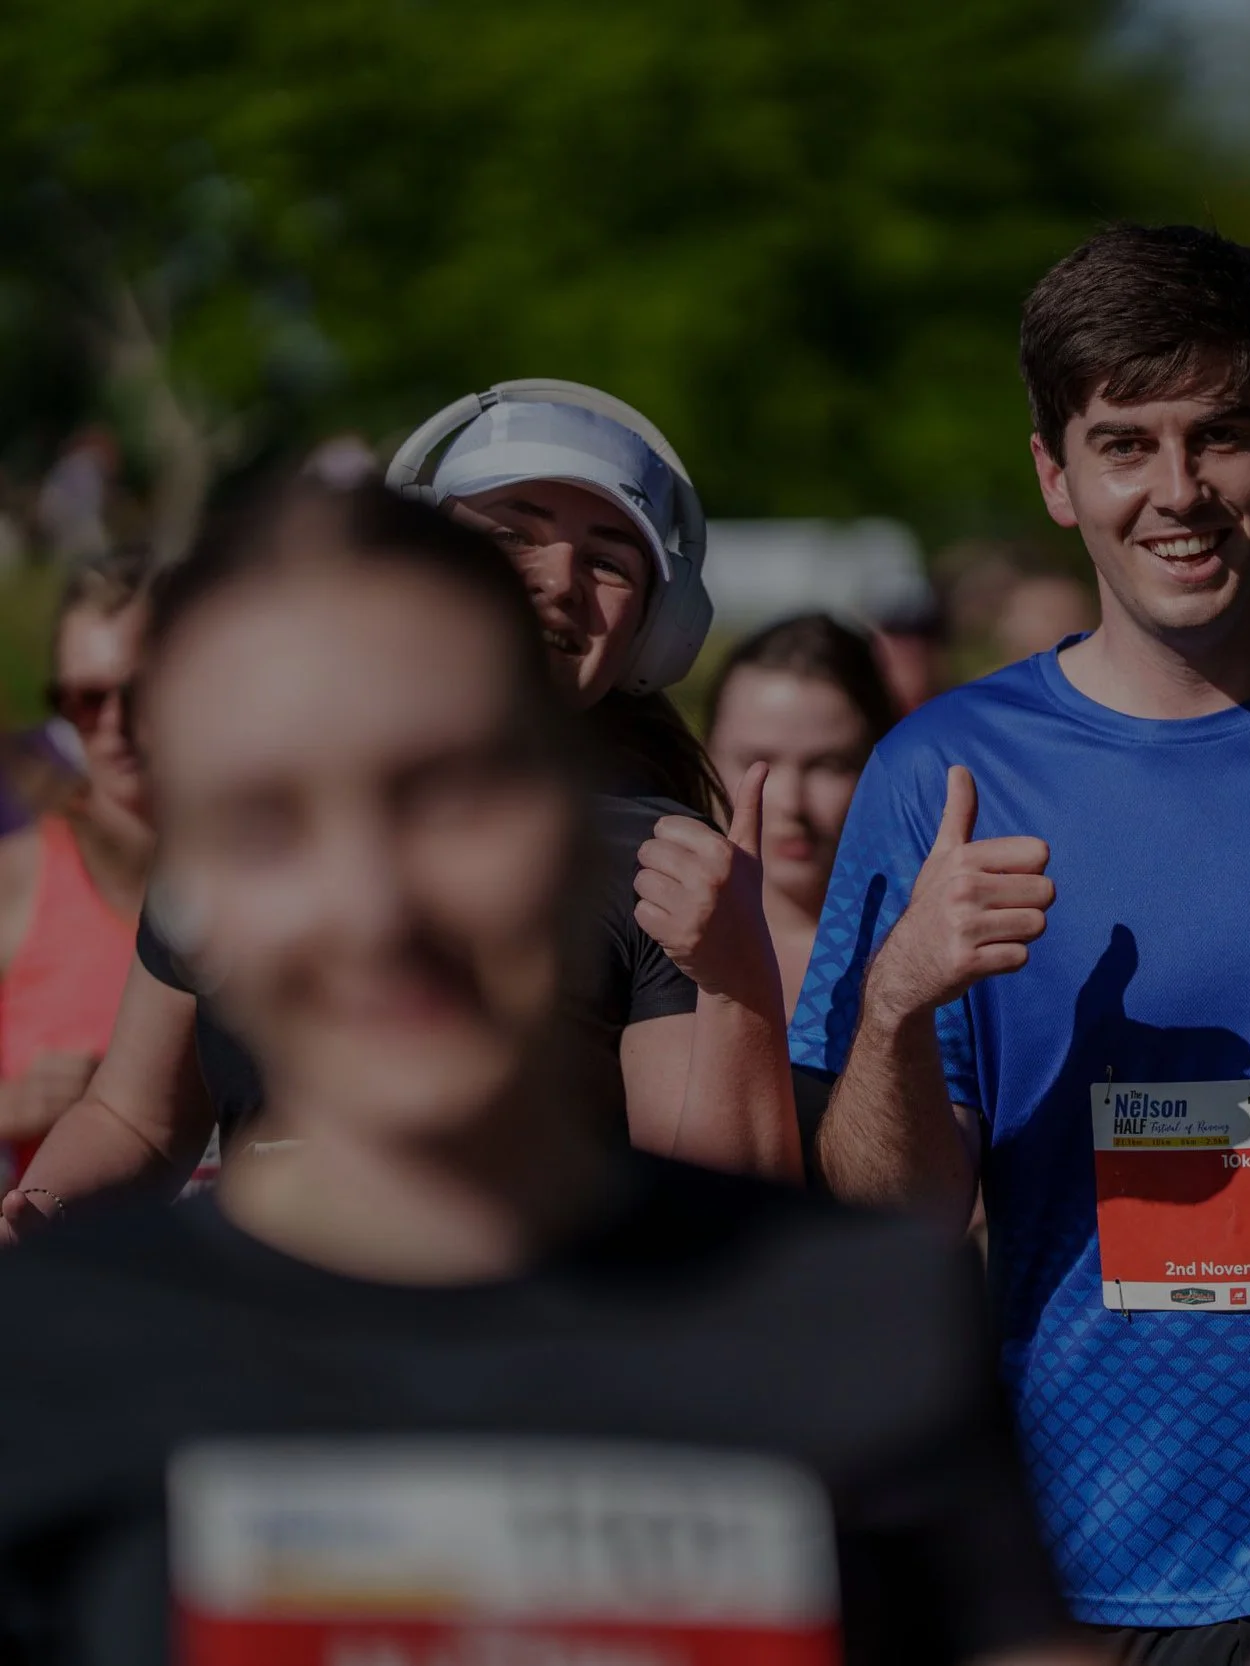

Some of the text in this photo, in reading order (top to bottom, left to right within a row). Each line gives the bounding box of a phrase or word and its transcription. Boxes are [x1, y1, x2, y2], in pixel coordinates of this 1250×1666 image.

[1130, 1089, 1142, 1099] The
[1114, 1093, 1187, 1118] Nelson
[1114, 1119, 1146, 1134] HALF
[1165, 1261, 1196, 1276] 2nd
